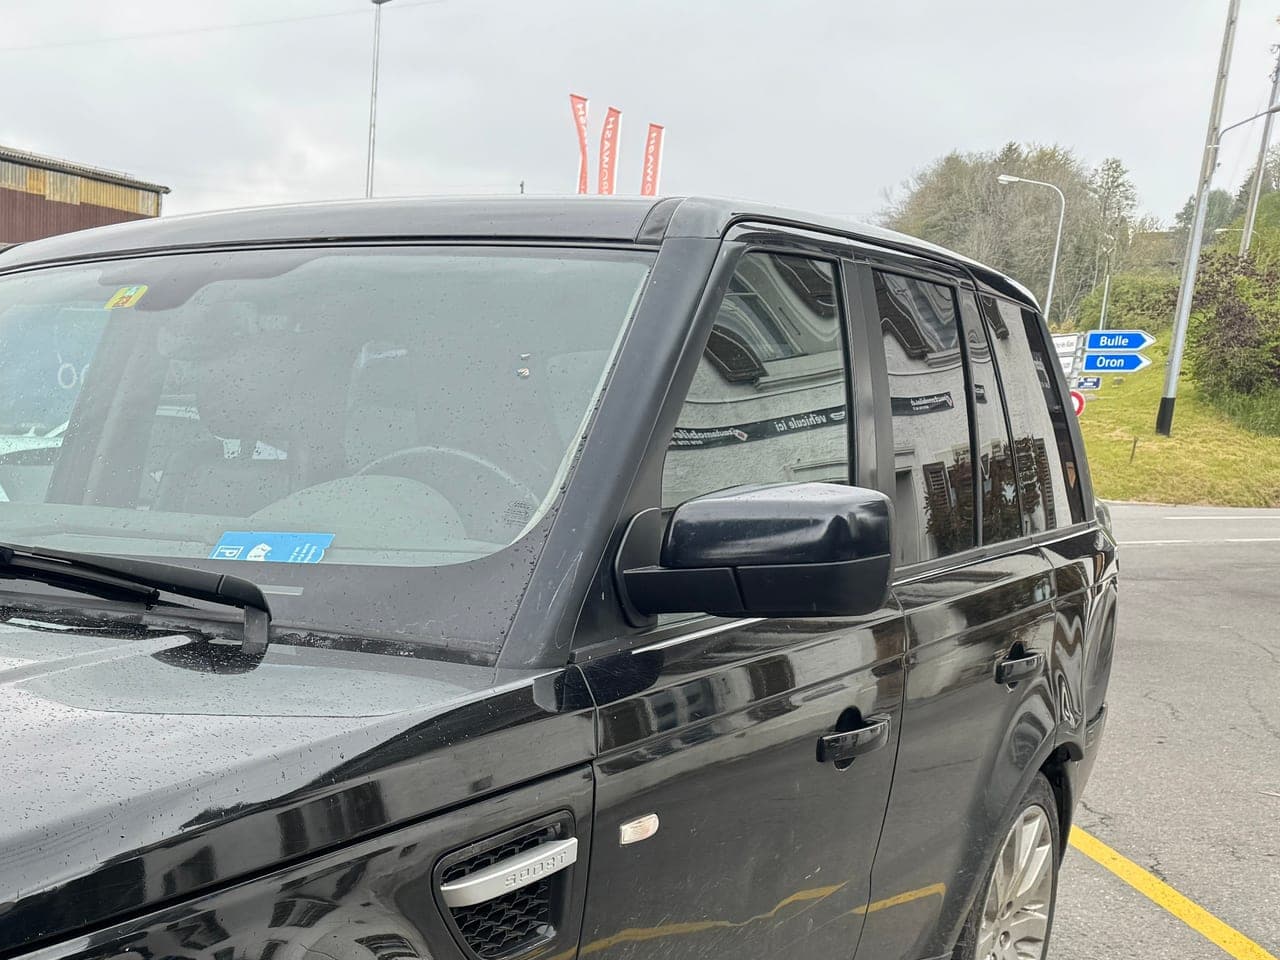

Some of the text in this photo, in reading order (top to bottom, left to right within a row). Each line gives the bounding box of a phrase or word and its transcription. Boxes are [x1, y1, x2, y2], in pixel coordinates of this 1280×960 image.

[1099, 336, 1129, 346] Bulle
[1096, 356, 1125, 367] Oron
[505, 851, 568, 887] SPORT
